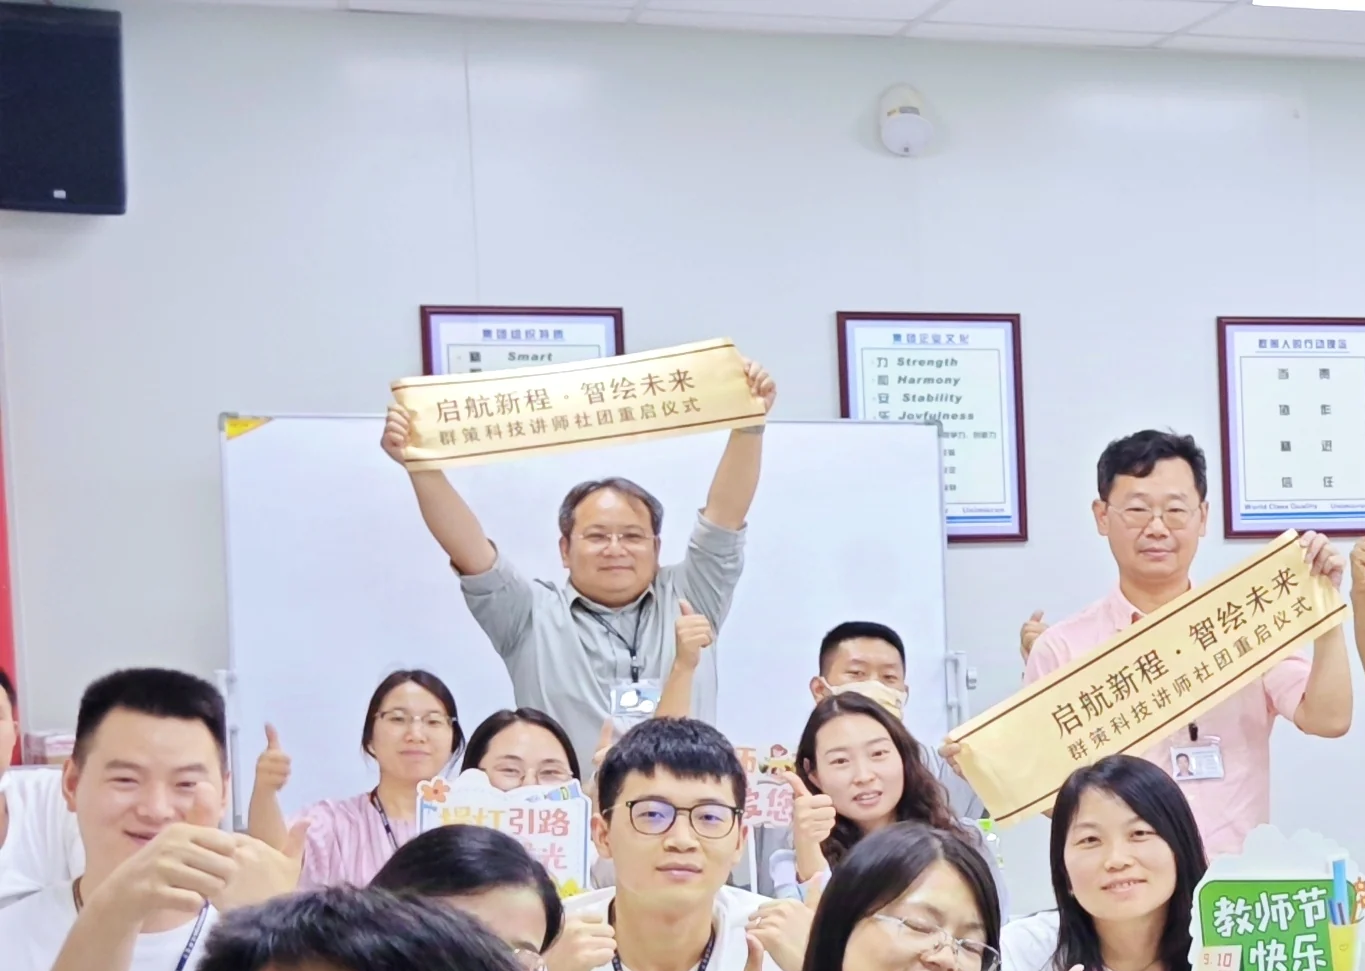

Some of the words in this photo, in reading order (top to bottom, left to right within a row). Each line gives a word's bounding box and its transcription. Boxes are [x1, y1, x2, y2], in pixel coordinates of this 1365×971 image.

[507, 351, 554, 362] Smart
[896, 357, 959, 370] Strength
[897, 375, 961, 387] Harmony
[901, 393, 963, 405] Stability
[438, 396, 701, 446] 群策科技讲师社团重启仪式
[1067, 596, 1313, 762] 群策科技讲师社团重启仪式
[1213, 886, 1329, 938] 教师节
